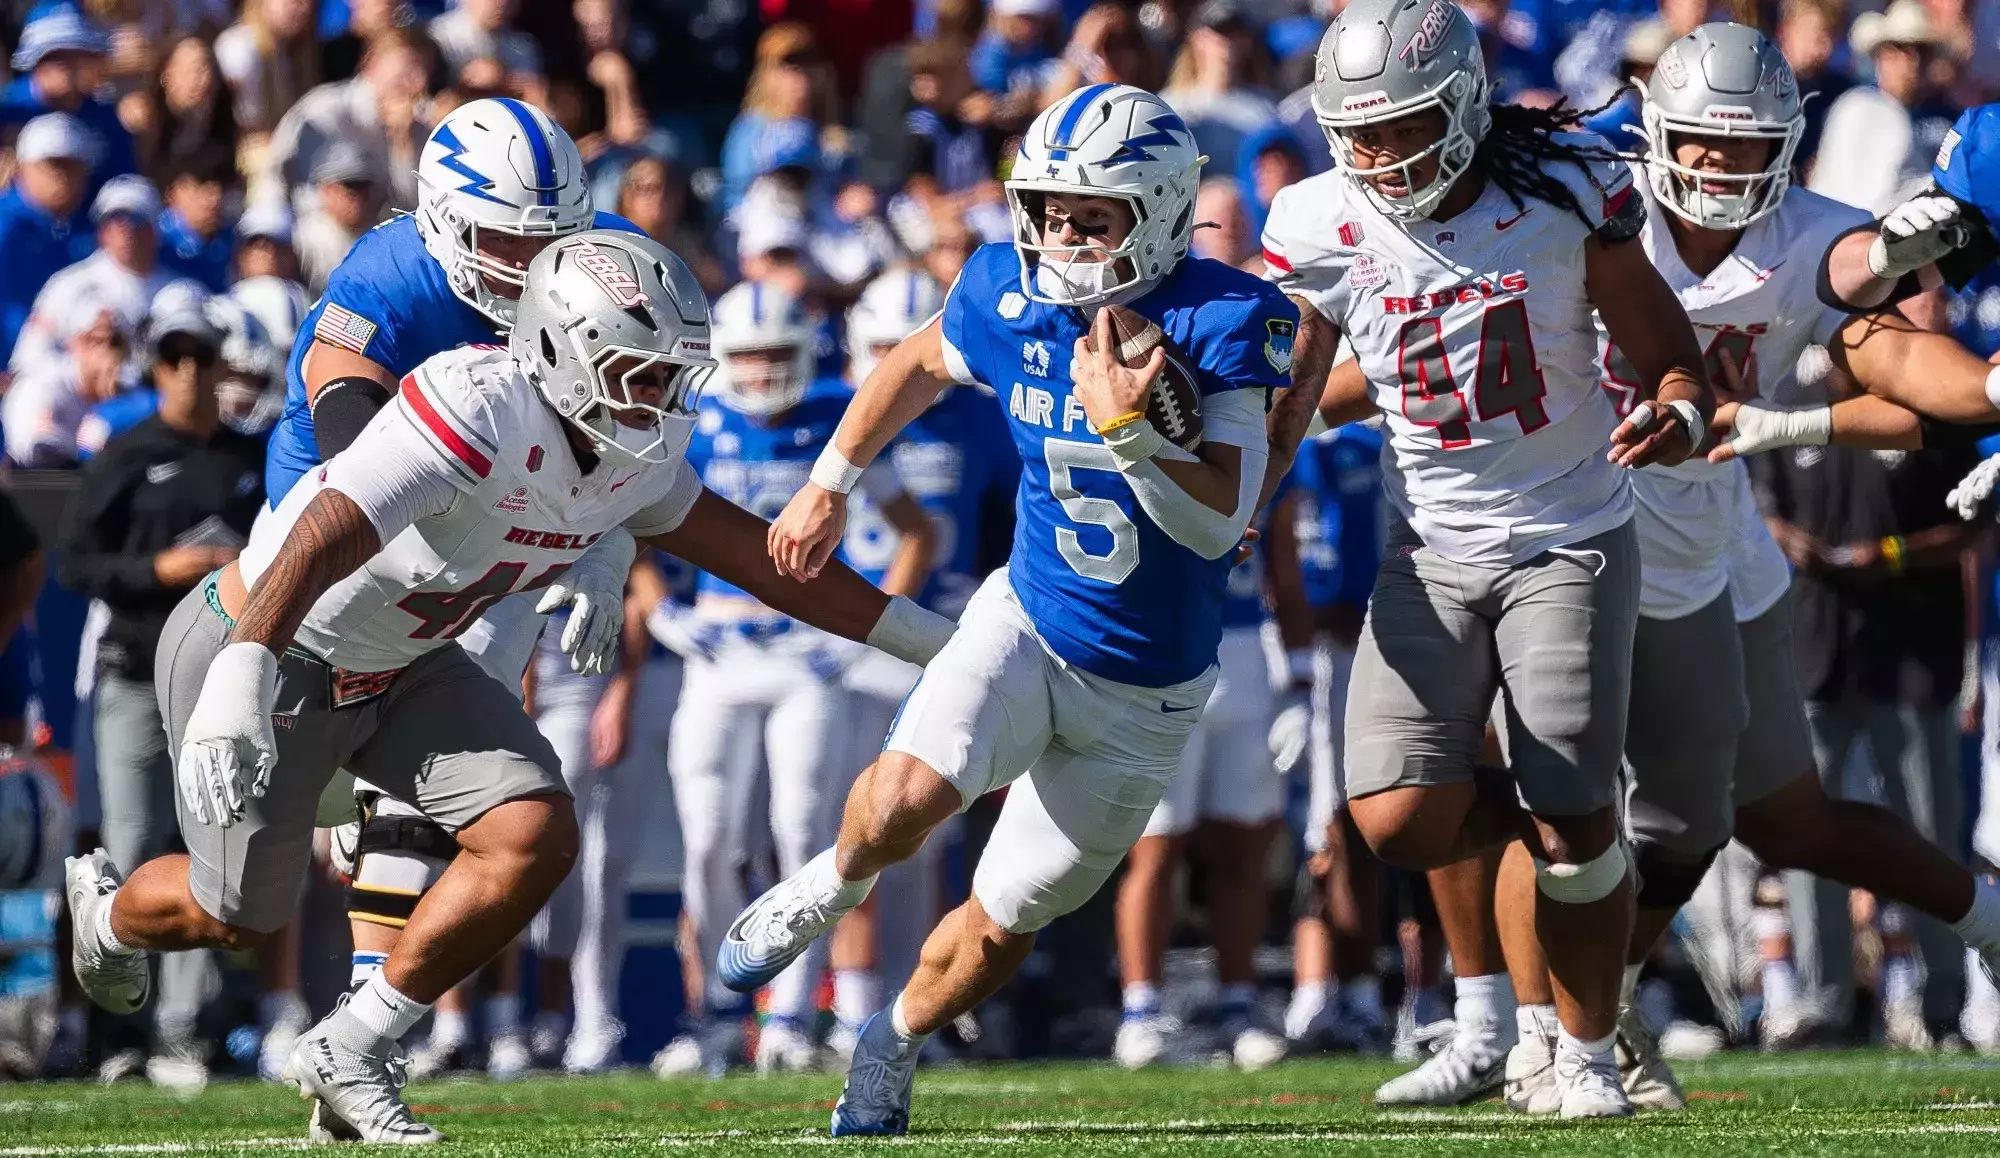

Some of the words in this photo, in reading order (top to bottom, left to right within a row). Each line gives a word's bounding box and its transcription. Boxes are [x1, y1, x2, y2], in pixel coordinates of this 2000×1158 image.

[1344, 96, 1388, 112] VEGAS
[561, 236, 650, 307] REBELS
[1023, 362, 1047, 378] USAA
[1399, 298, 1552, 450] 44
[1010, 382, 1055, 429] AIR
[496, 502, 527, 513] Biologics
[503, 495, 529, 505] Acesso
[1043, 436, 1141, 585] 5
[271, 715, 293, 730] NLV
